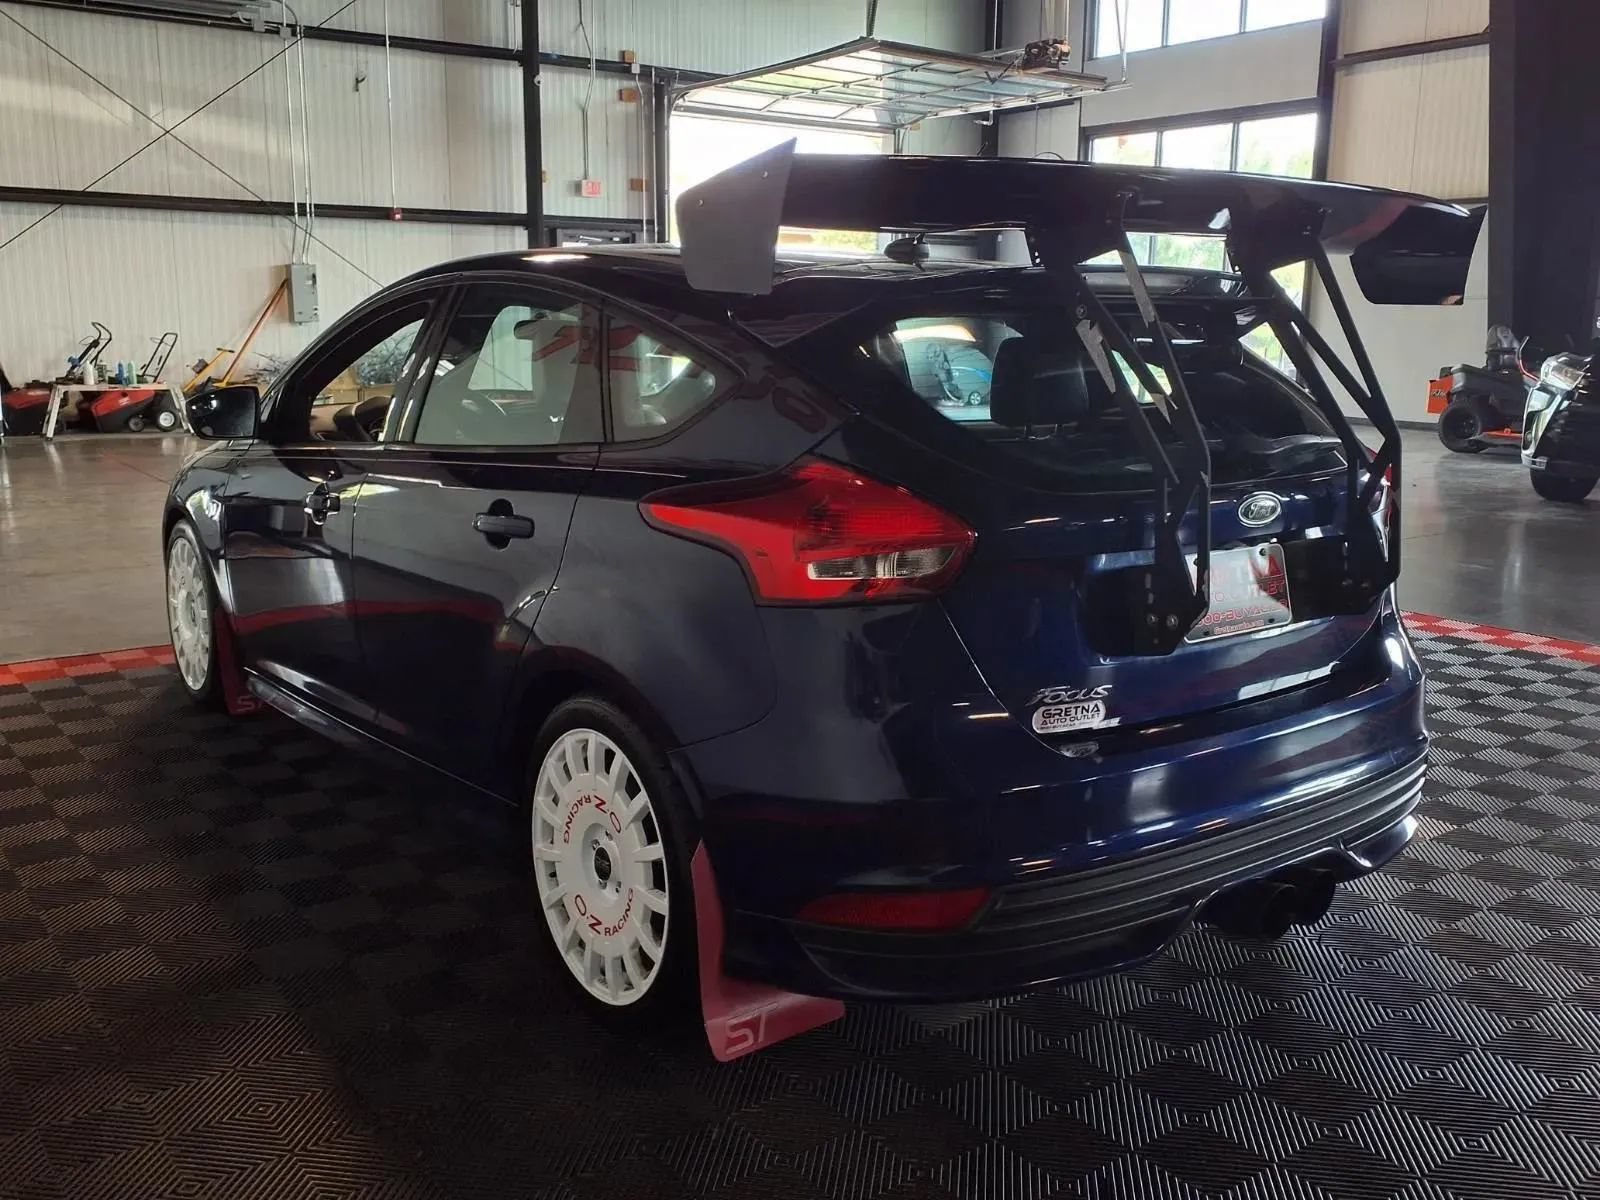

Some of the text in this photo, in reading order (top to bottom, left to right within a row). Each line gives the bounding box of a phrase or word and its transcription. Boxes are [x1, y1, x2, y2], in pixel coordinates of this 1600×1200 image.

[1041, 712, 1101, 726] AUTO OUTLET
[1042, 704, 1101, 719] GRETNA
[563, 794, 592, 844] RACING
[604, 888, 634, 937] RACING
